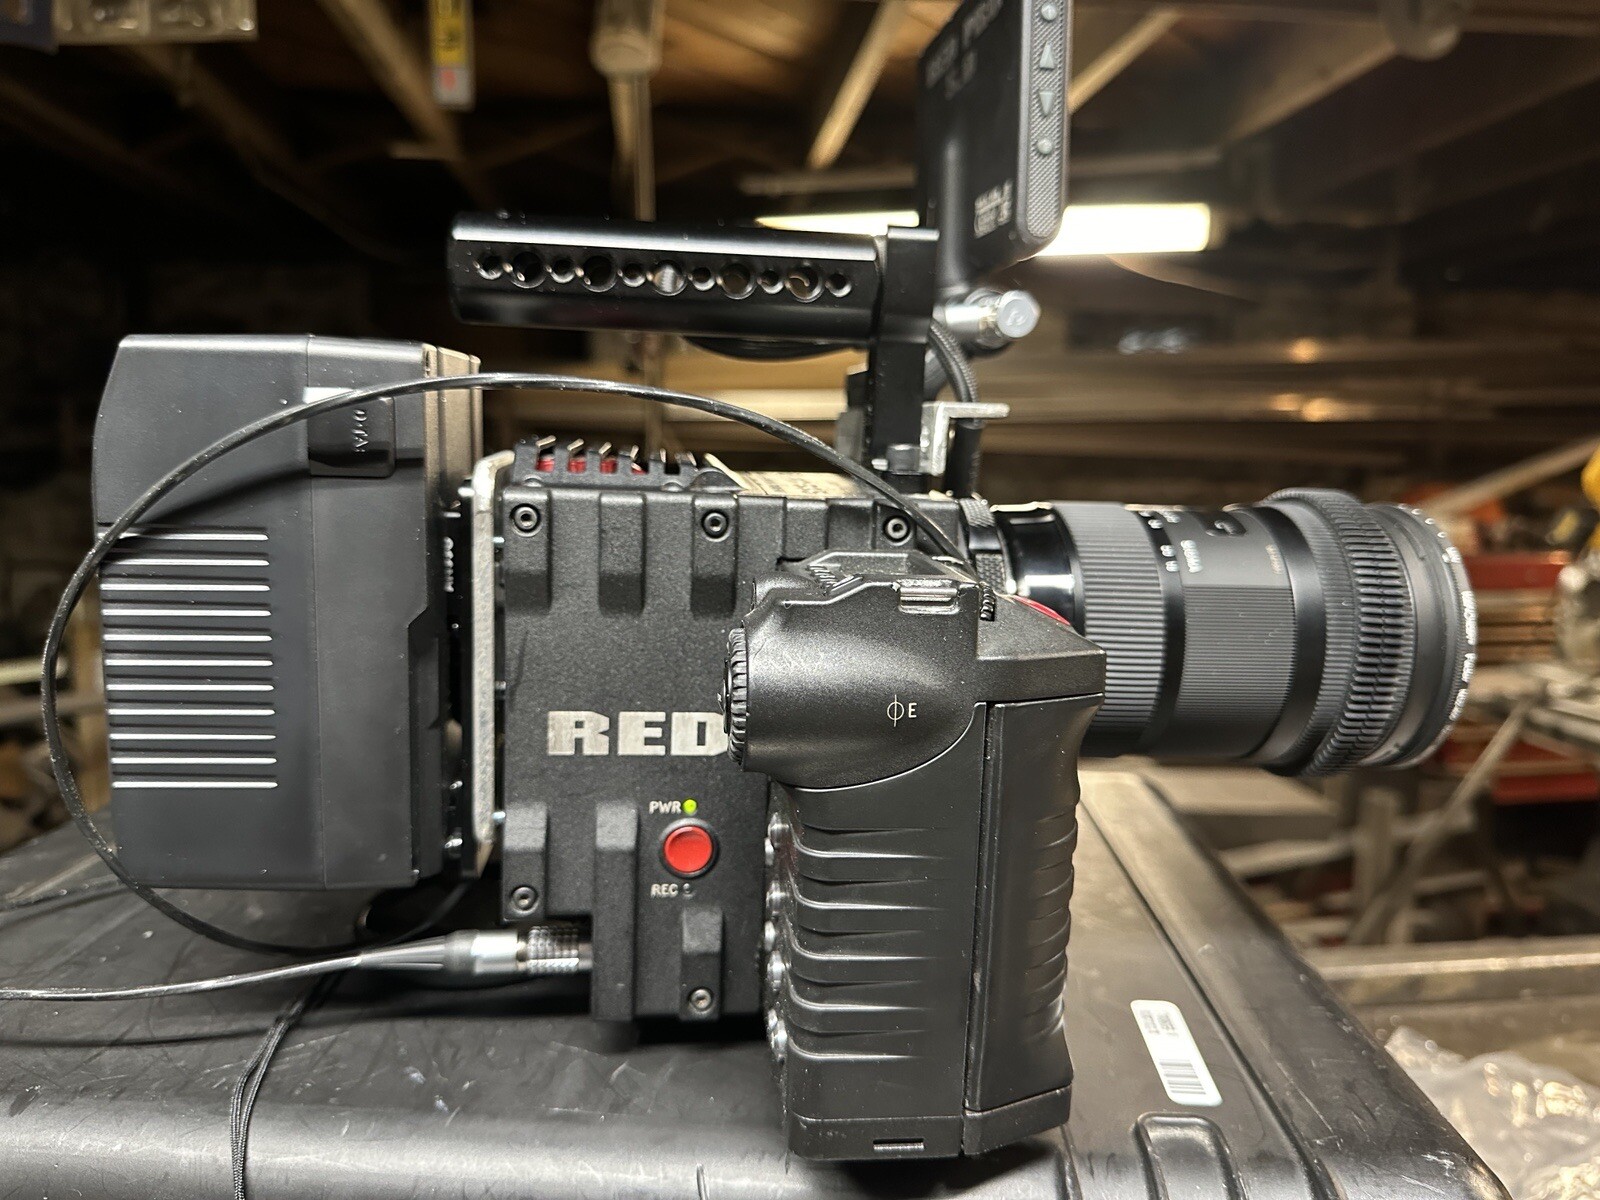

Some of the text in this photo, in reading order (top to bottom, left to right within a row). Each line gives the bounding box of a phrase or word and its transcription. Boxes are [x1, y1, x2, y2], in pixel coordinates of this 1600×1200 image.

[908, 702, 918, 718] E
[547, 710, 730, 756] RED
[649, 800, 682, 815] PWR
[651, 883, 679, 900] REC
